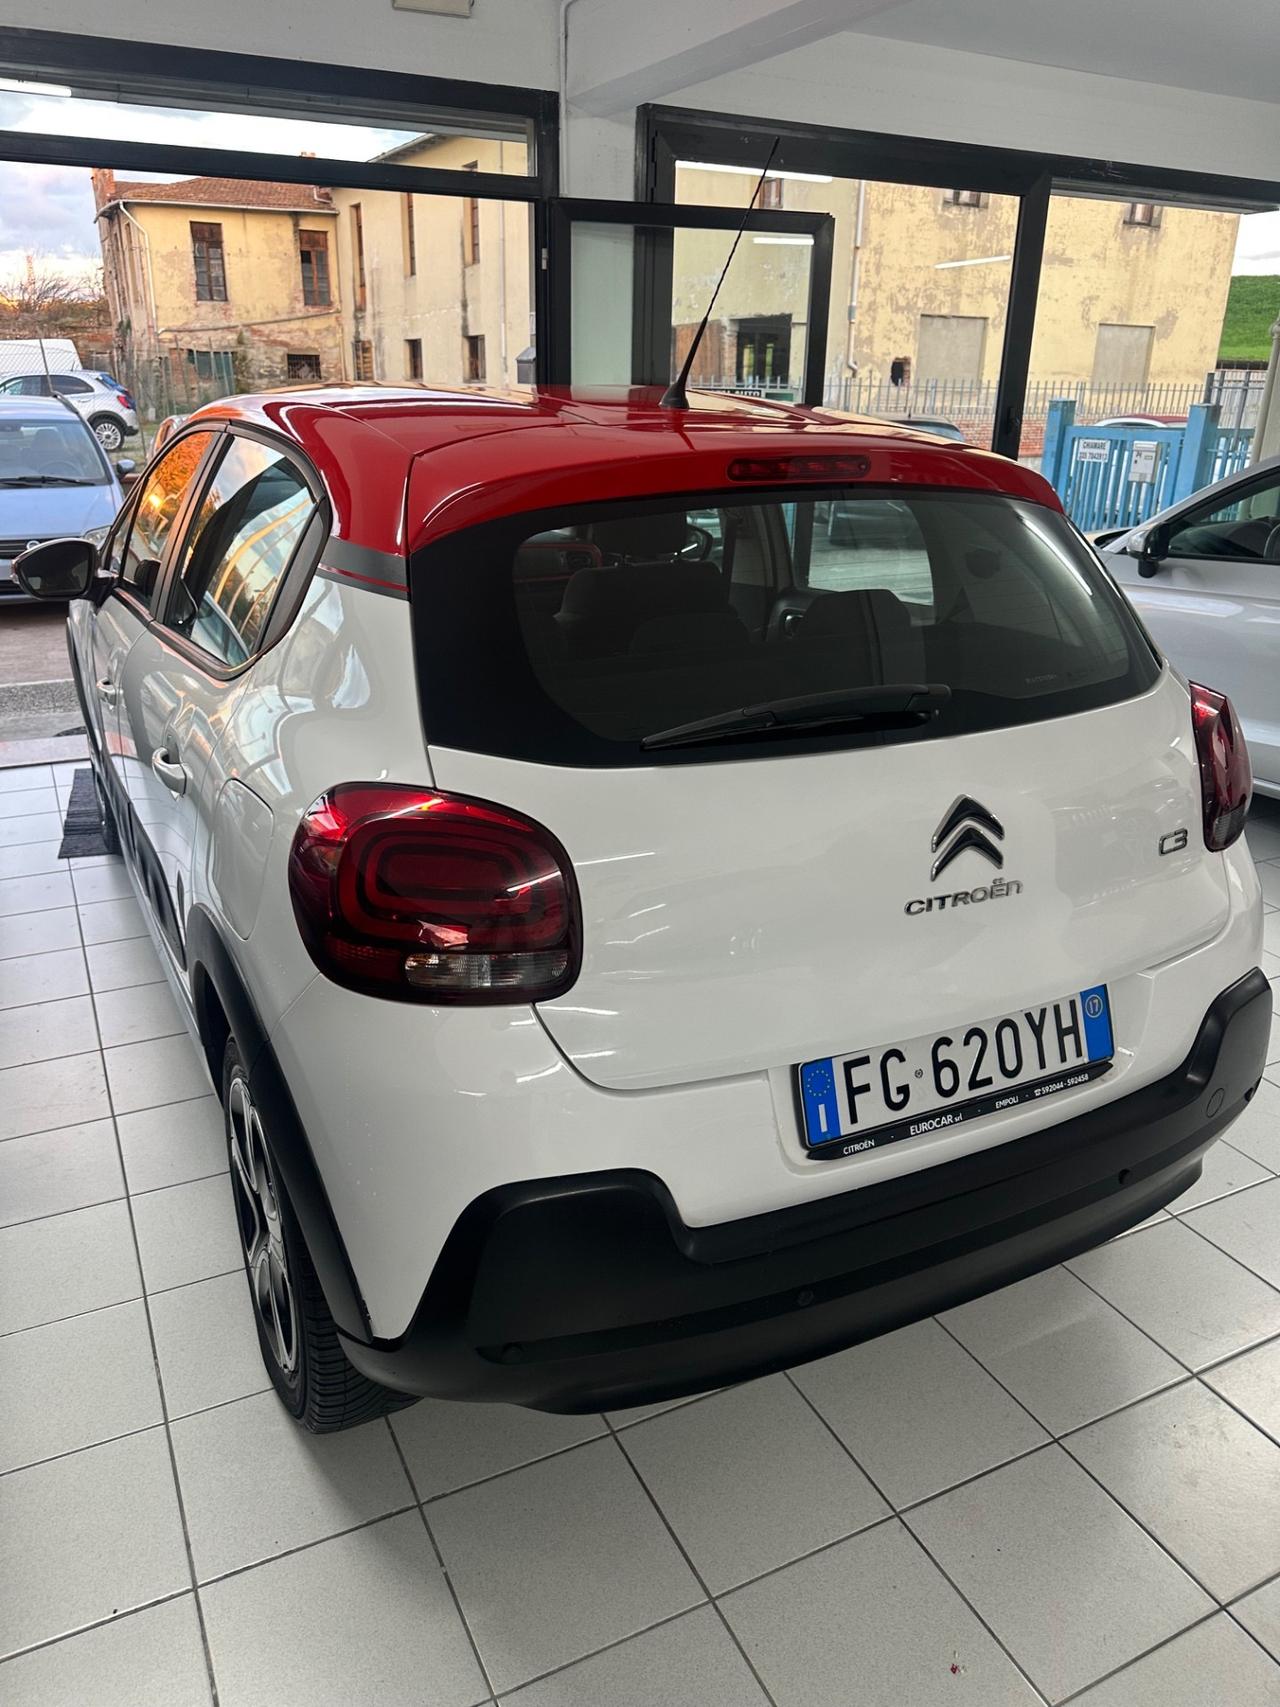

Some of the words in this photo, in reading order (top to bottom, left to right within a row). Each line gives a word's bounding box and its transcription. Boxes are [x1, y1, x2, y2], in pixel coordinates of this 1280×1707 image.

[1083, 441, 1106, 450] CHIAMARE
[1159, 828, 1188, 856] C3
[843, 1138, 875, 1155] CITROËN
[910, 1114, 954, 1136] EUROCAR
[954, 1112, 963, 1123] srl
[995, 1096, 1019, 1109] EMPOLI
